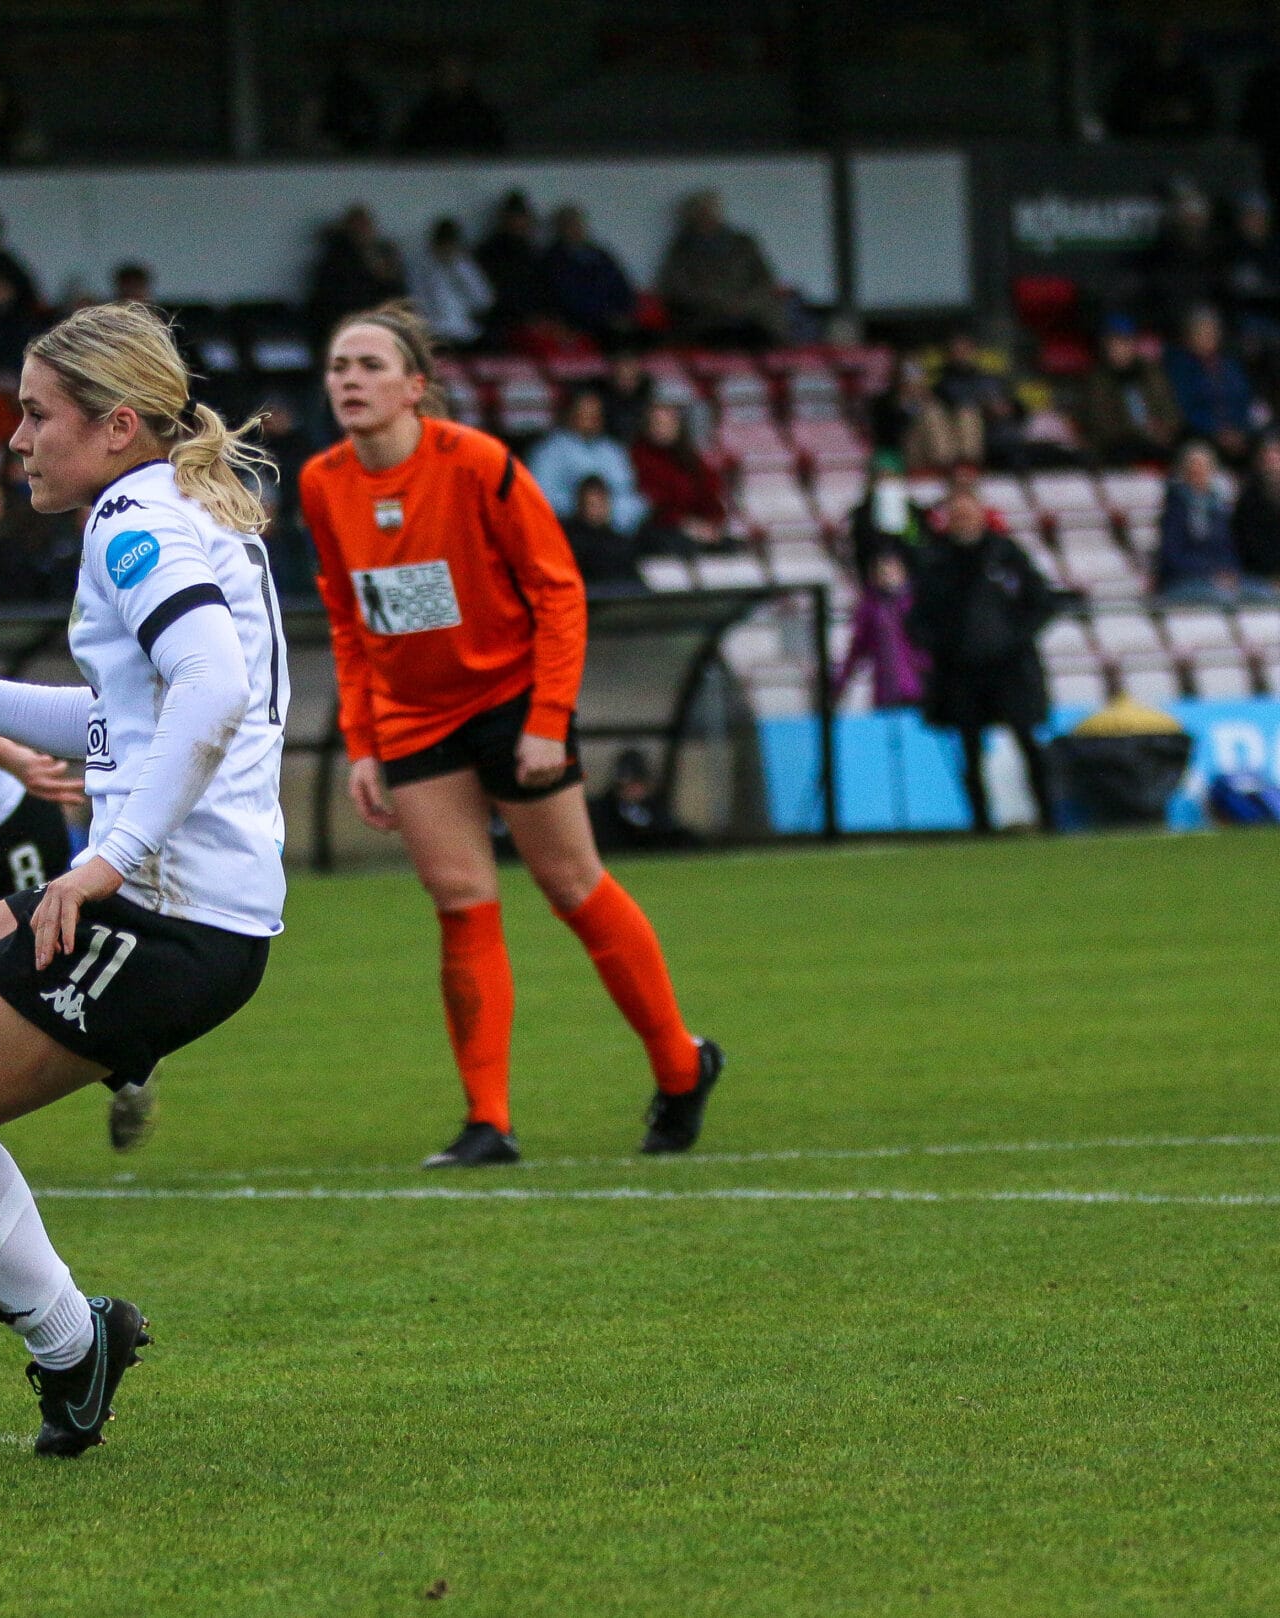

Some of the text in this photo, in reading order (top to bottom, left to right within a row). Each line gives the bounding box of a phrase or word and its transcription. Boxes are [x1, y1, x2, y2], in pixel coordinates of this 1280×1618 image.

[111, 542, 153, 581] xero
[9, 844, 47, 891] 8
[69, 924, 137, 1000] 11
